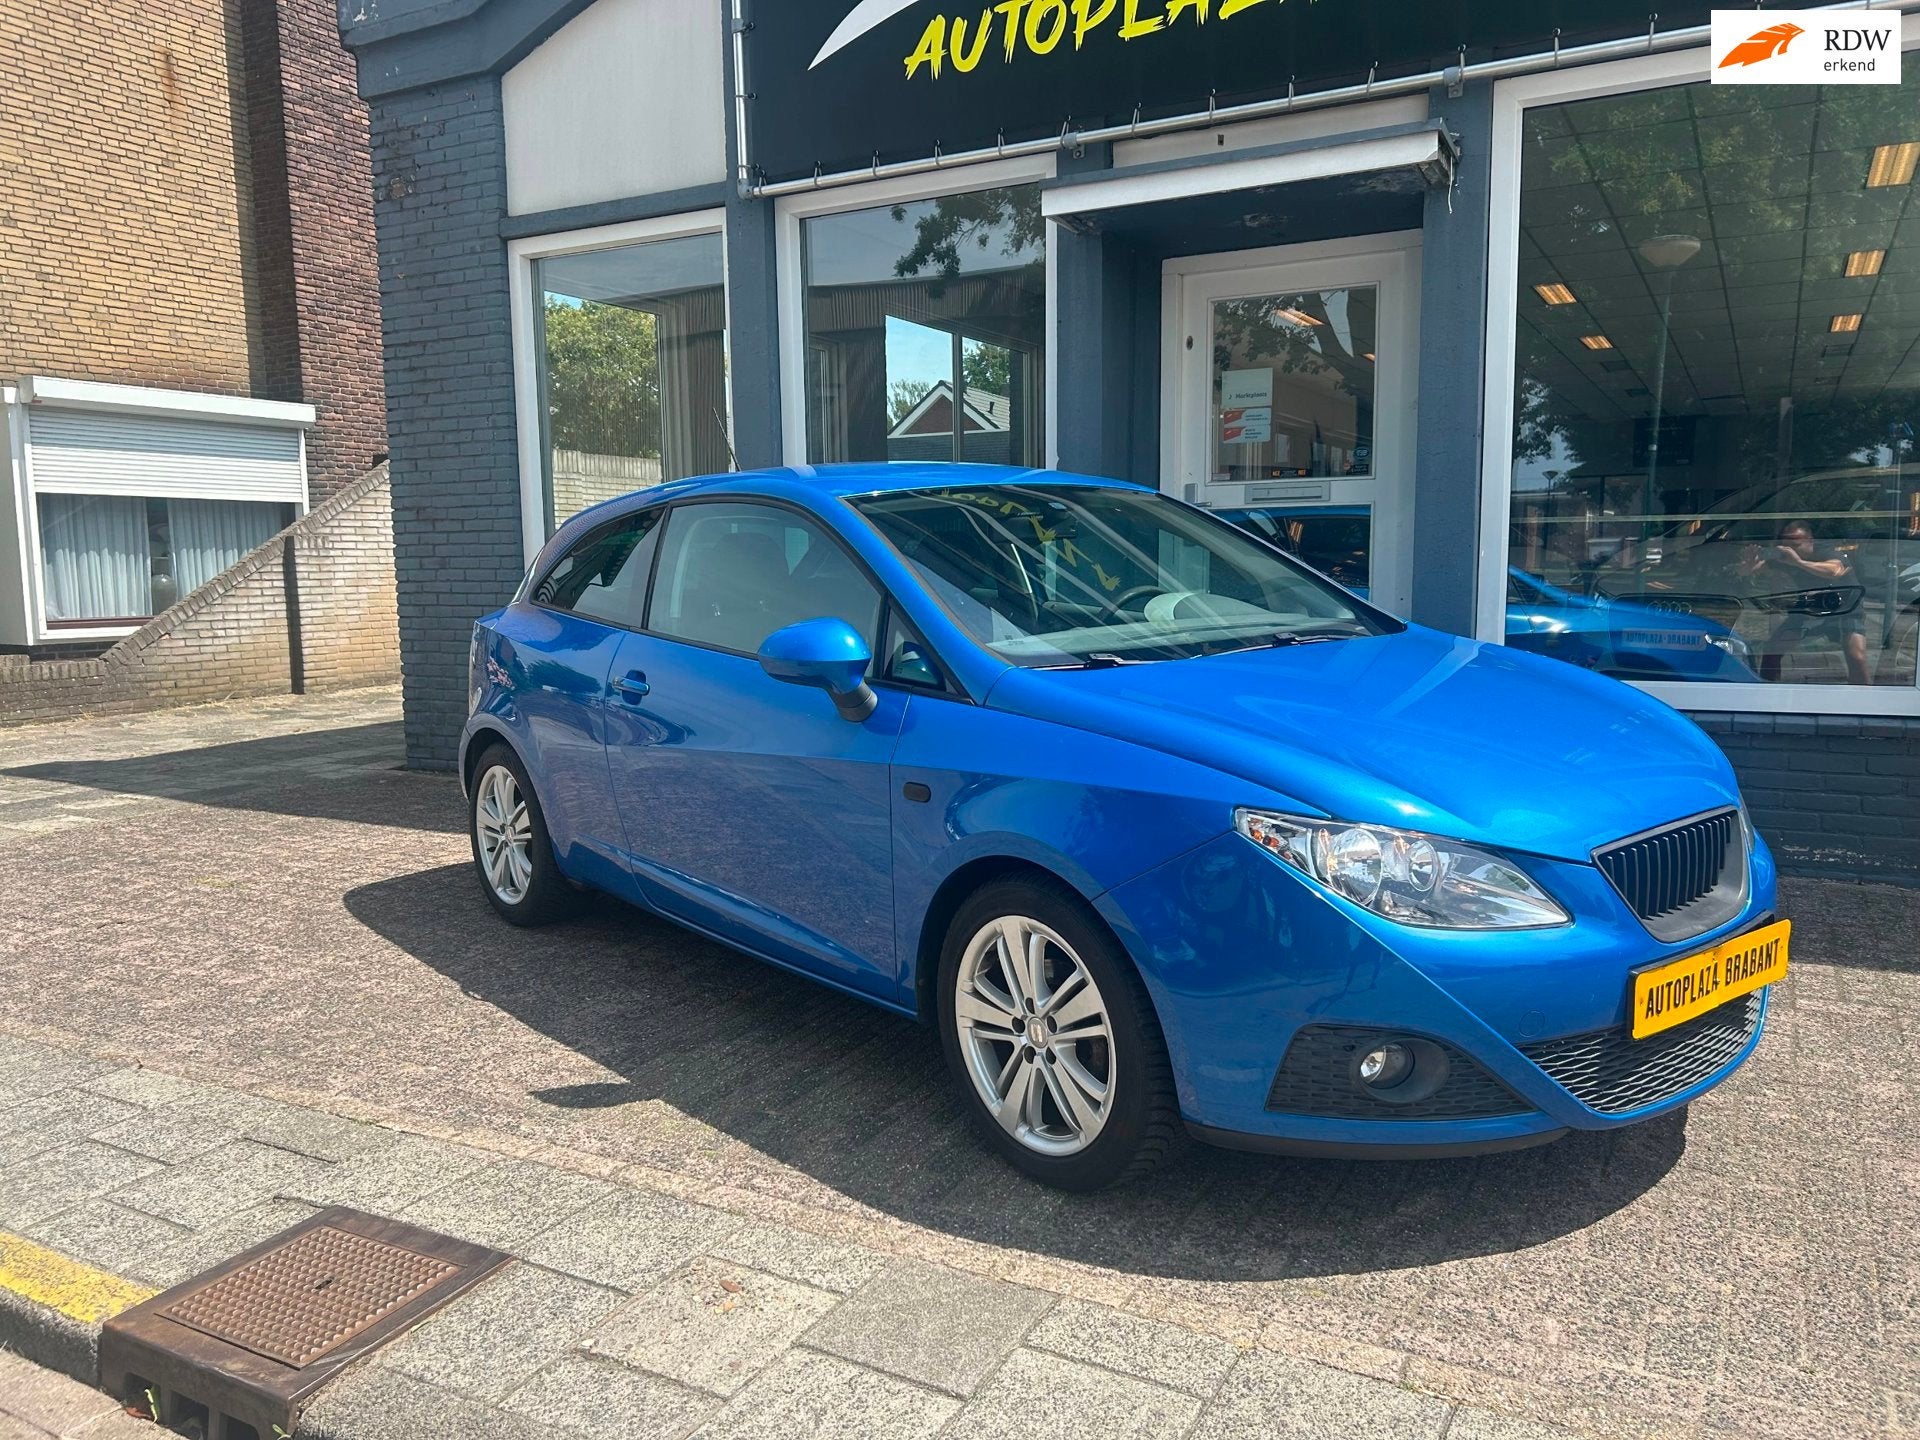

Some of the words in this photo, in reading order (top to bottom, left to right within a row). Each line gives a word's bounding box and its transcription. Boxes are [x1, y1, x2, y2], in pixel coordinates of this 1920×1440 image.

[903, 0, 1320, 81] AUTOPL
[1645, 962, 1719, 1019] AUTOPLAZA
[1724, 937, 1780, 987] BRABANT
